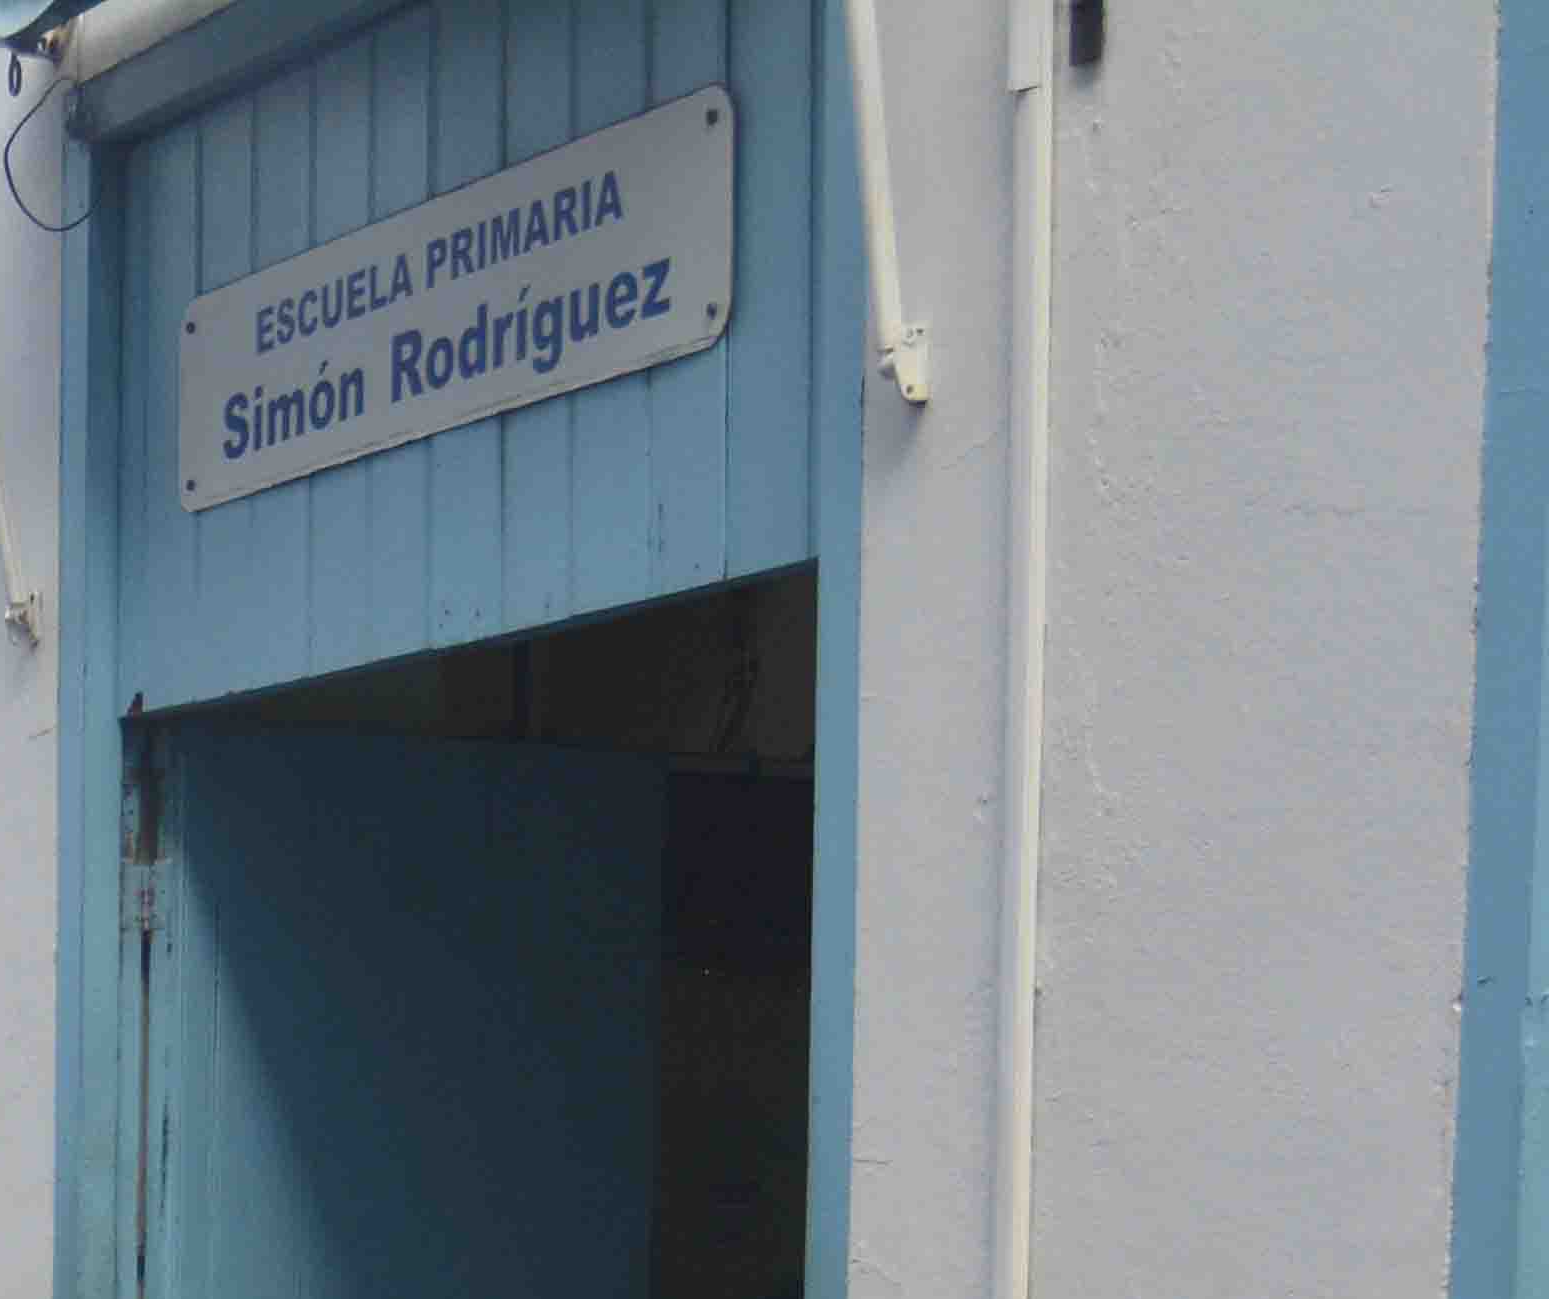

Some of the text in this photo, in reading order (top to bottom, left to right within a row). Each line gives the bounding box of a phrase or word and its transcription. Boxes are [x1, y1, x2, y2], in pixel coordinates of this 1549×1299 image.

[221, 257, 672, 460] Simón Rodríguez
[255, 169, 624, 357] ESCUELA PRIMARIA
